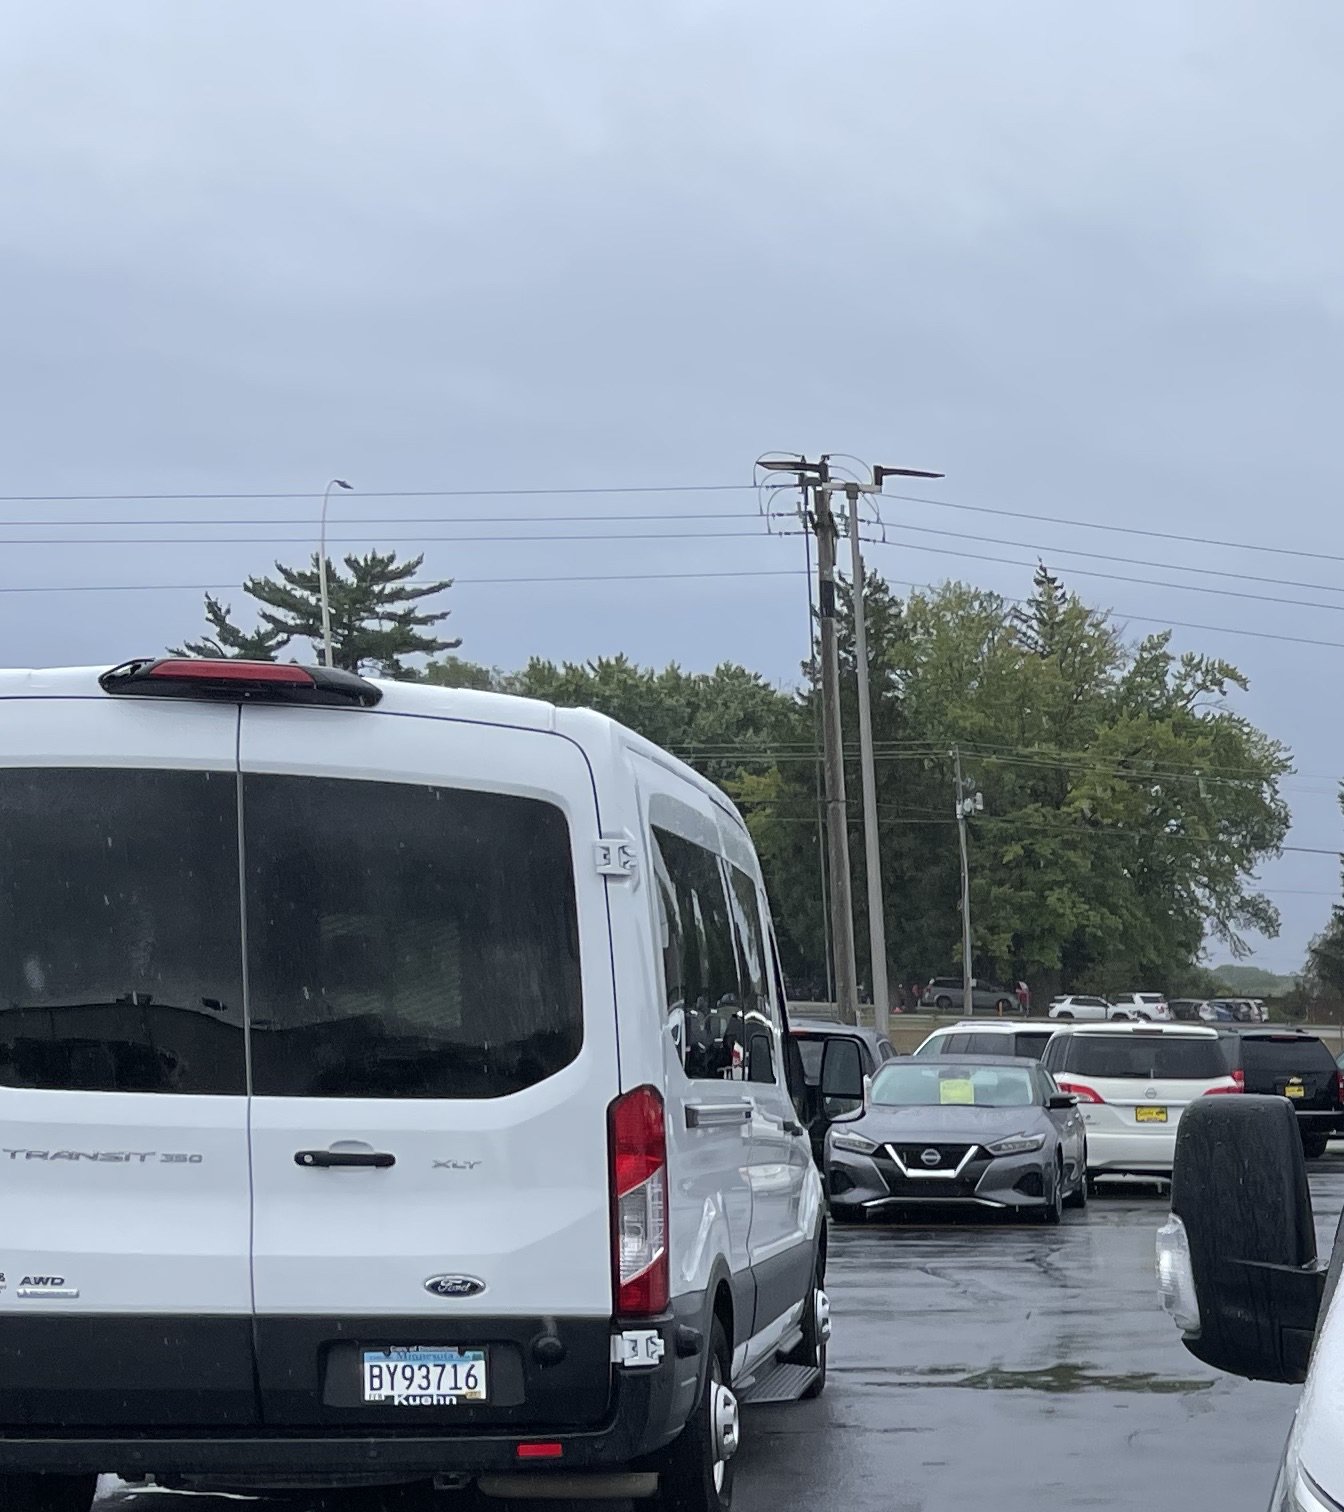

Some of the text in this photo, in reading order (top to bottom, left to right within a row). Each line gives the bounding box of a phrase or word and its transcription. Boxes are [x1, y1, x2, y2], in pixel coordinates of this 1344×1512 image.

[2, 1148, 156, 1163] TRANSIT
[432, 1160, 482, 1169] XLT
[20, 1275, 65, 1286] AWD
[369, 1364, 478, 1392] BY93716
[394, 1394, 457, 1406] Kuehn
